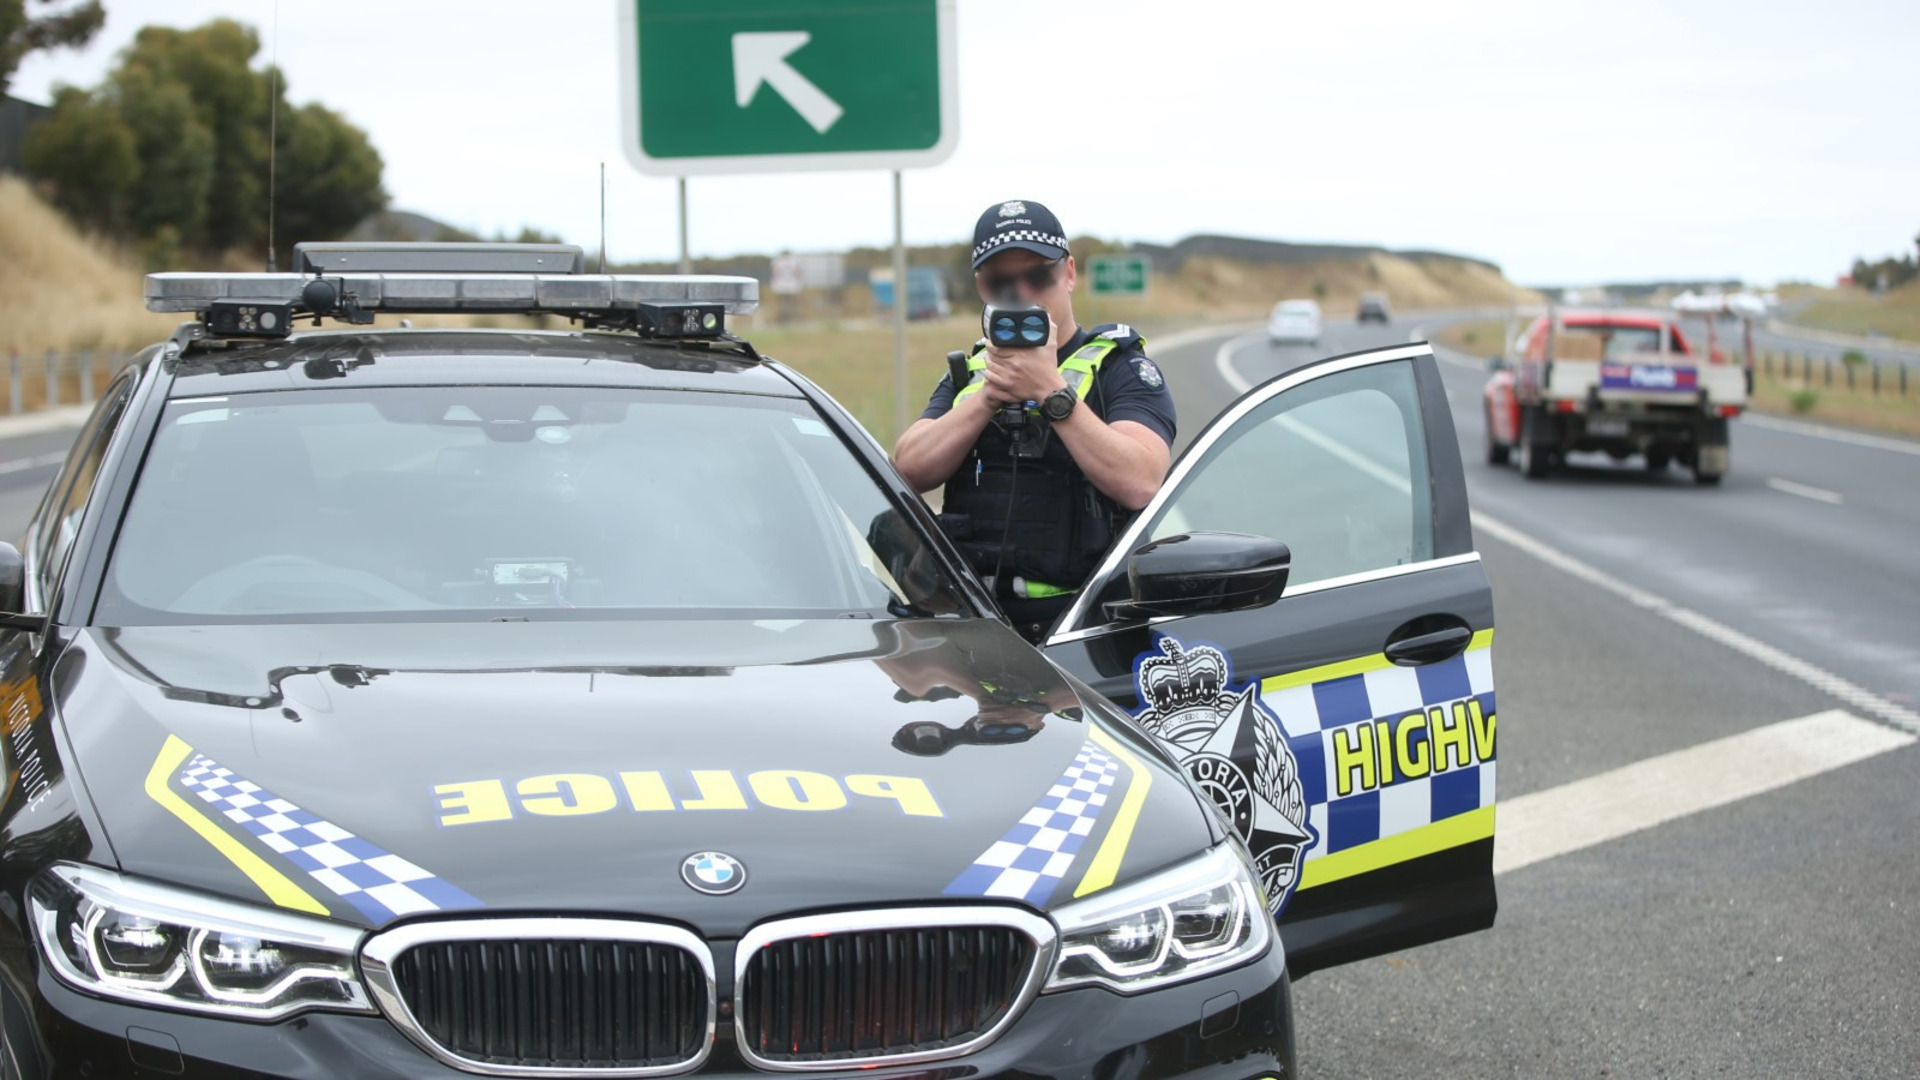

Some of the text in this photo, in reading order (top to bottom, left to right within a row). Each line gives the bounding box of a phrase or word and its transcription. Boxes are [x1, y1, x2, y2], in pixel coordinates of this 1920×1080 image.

[8, 691, 51, 812] VICTORIA POLICE
[1184, 758, 1248, 807] TORIA
